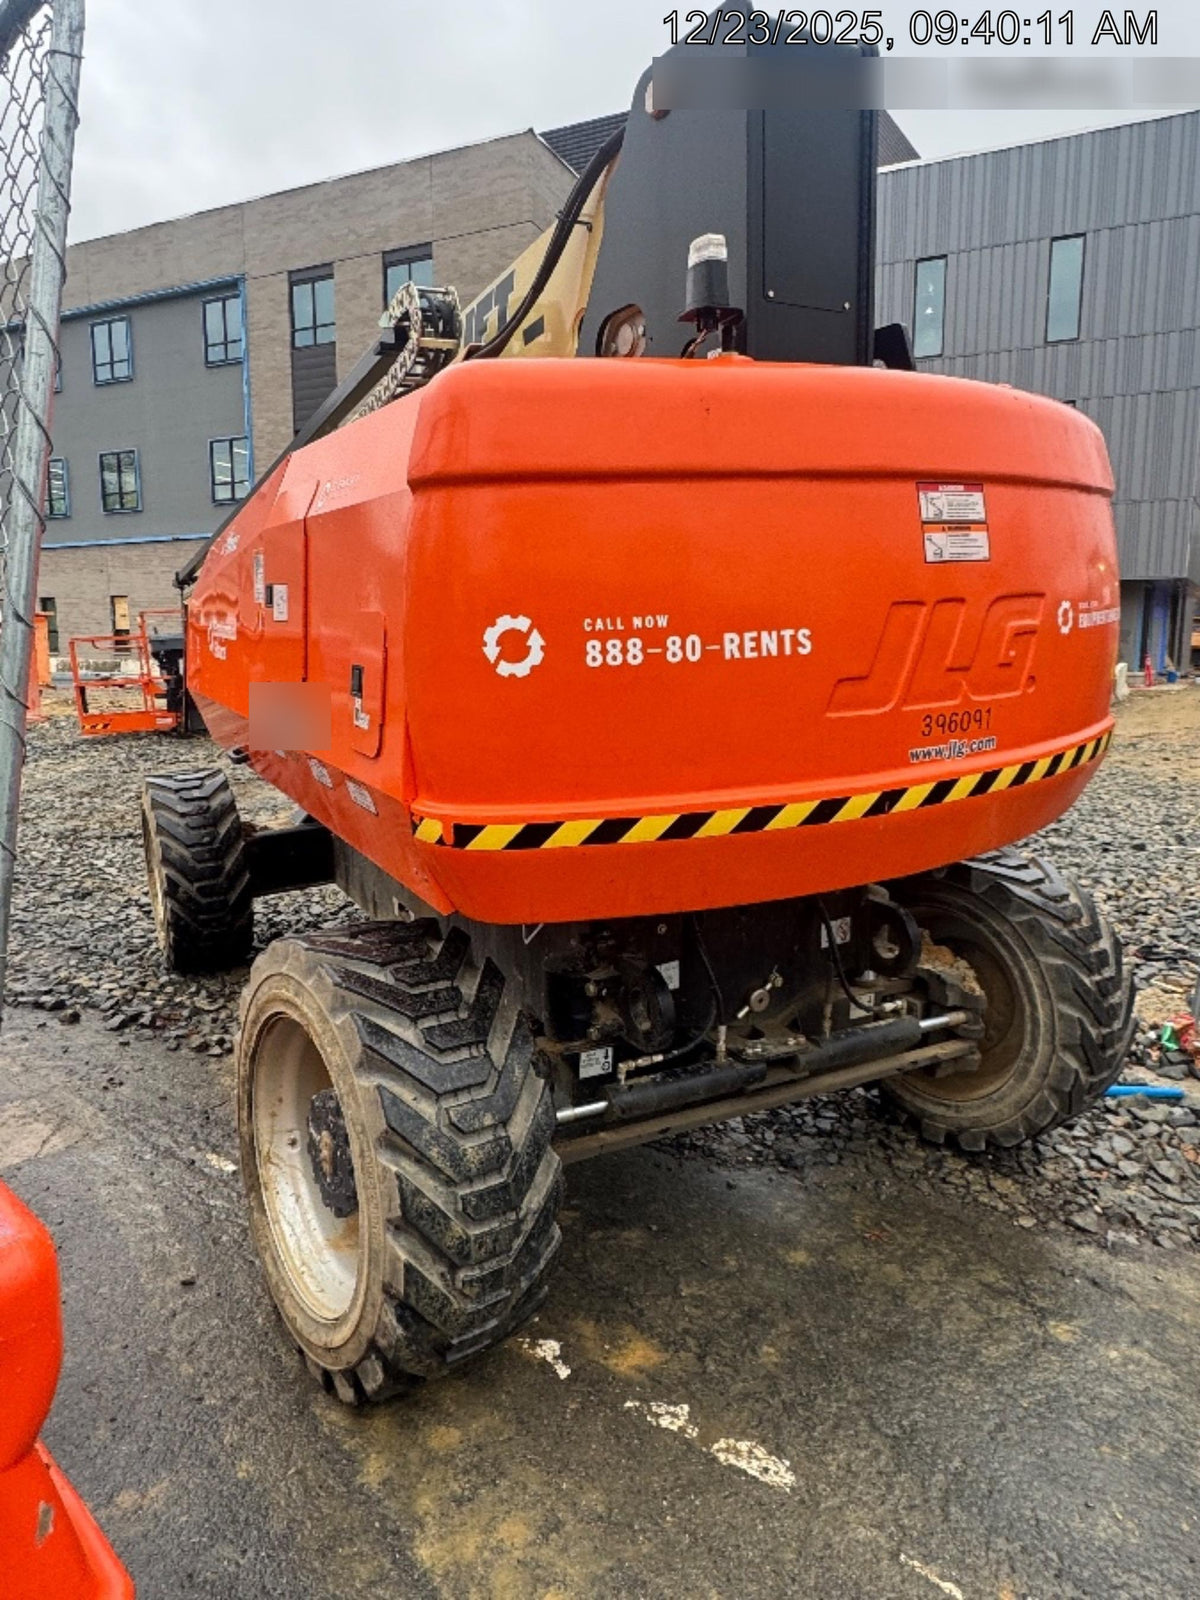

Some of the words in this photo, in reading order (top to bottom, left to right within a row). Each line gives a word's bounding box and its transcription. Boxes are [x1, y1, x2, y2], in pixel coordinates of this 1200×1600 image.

[583, 617, 625, 631] CALL
[632, 615, 669, 629] NOW
[585, 628, 812, 667] 888-80-RENTS
[825, 592, 1046, 717] JLG
[921, 707, 992, 737] 396091
[908, 736, 997, 762] www.jlg.com
